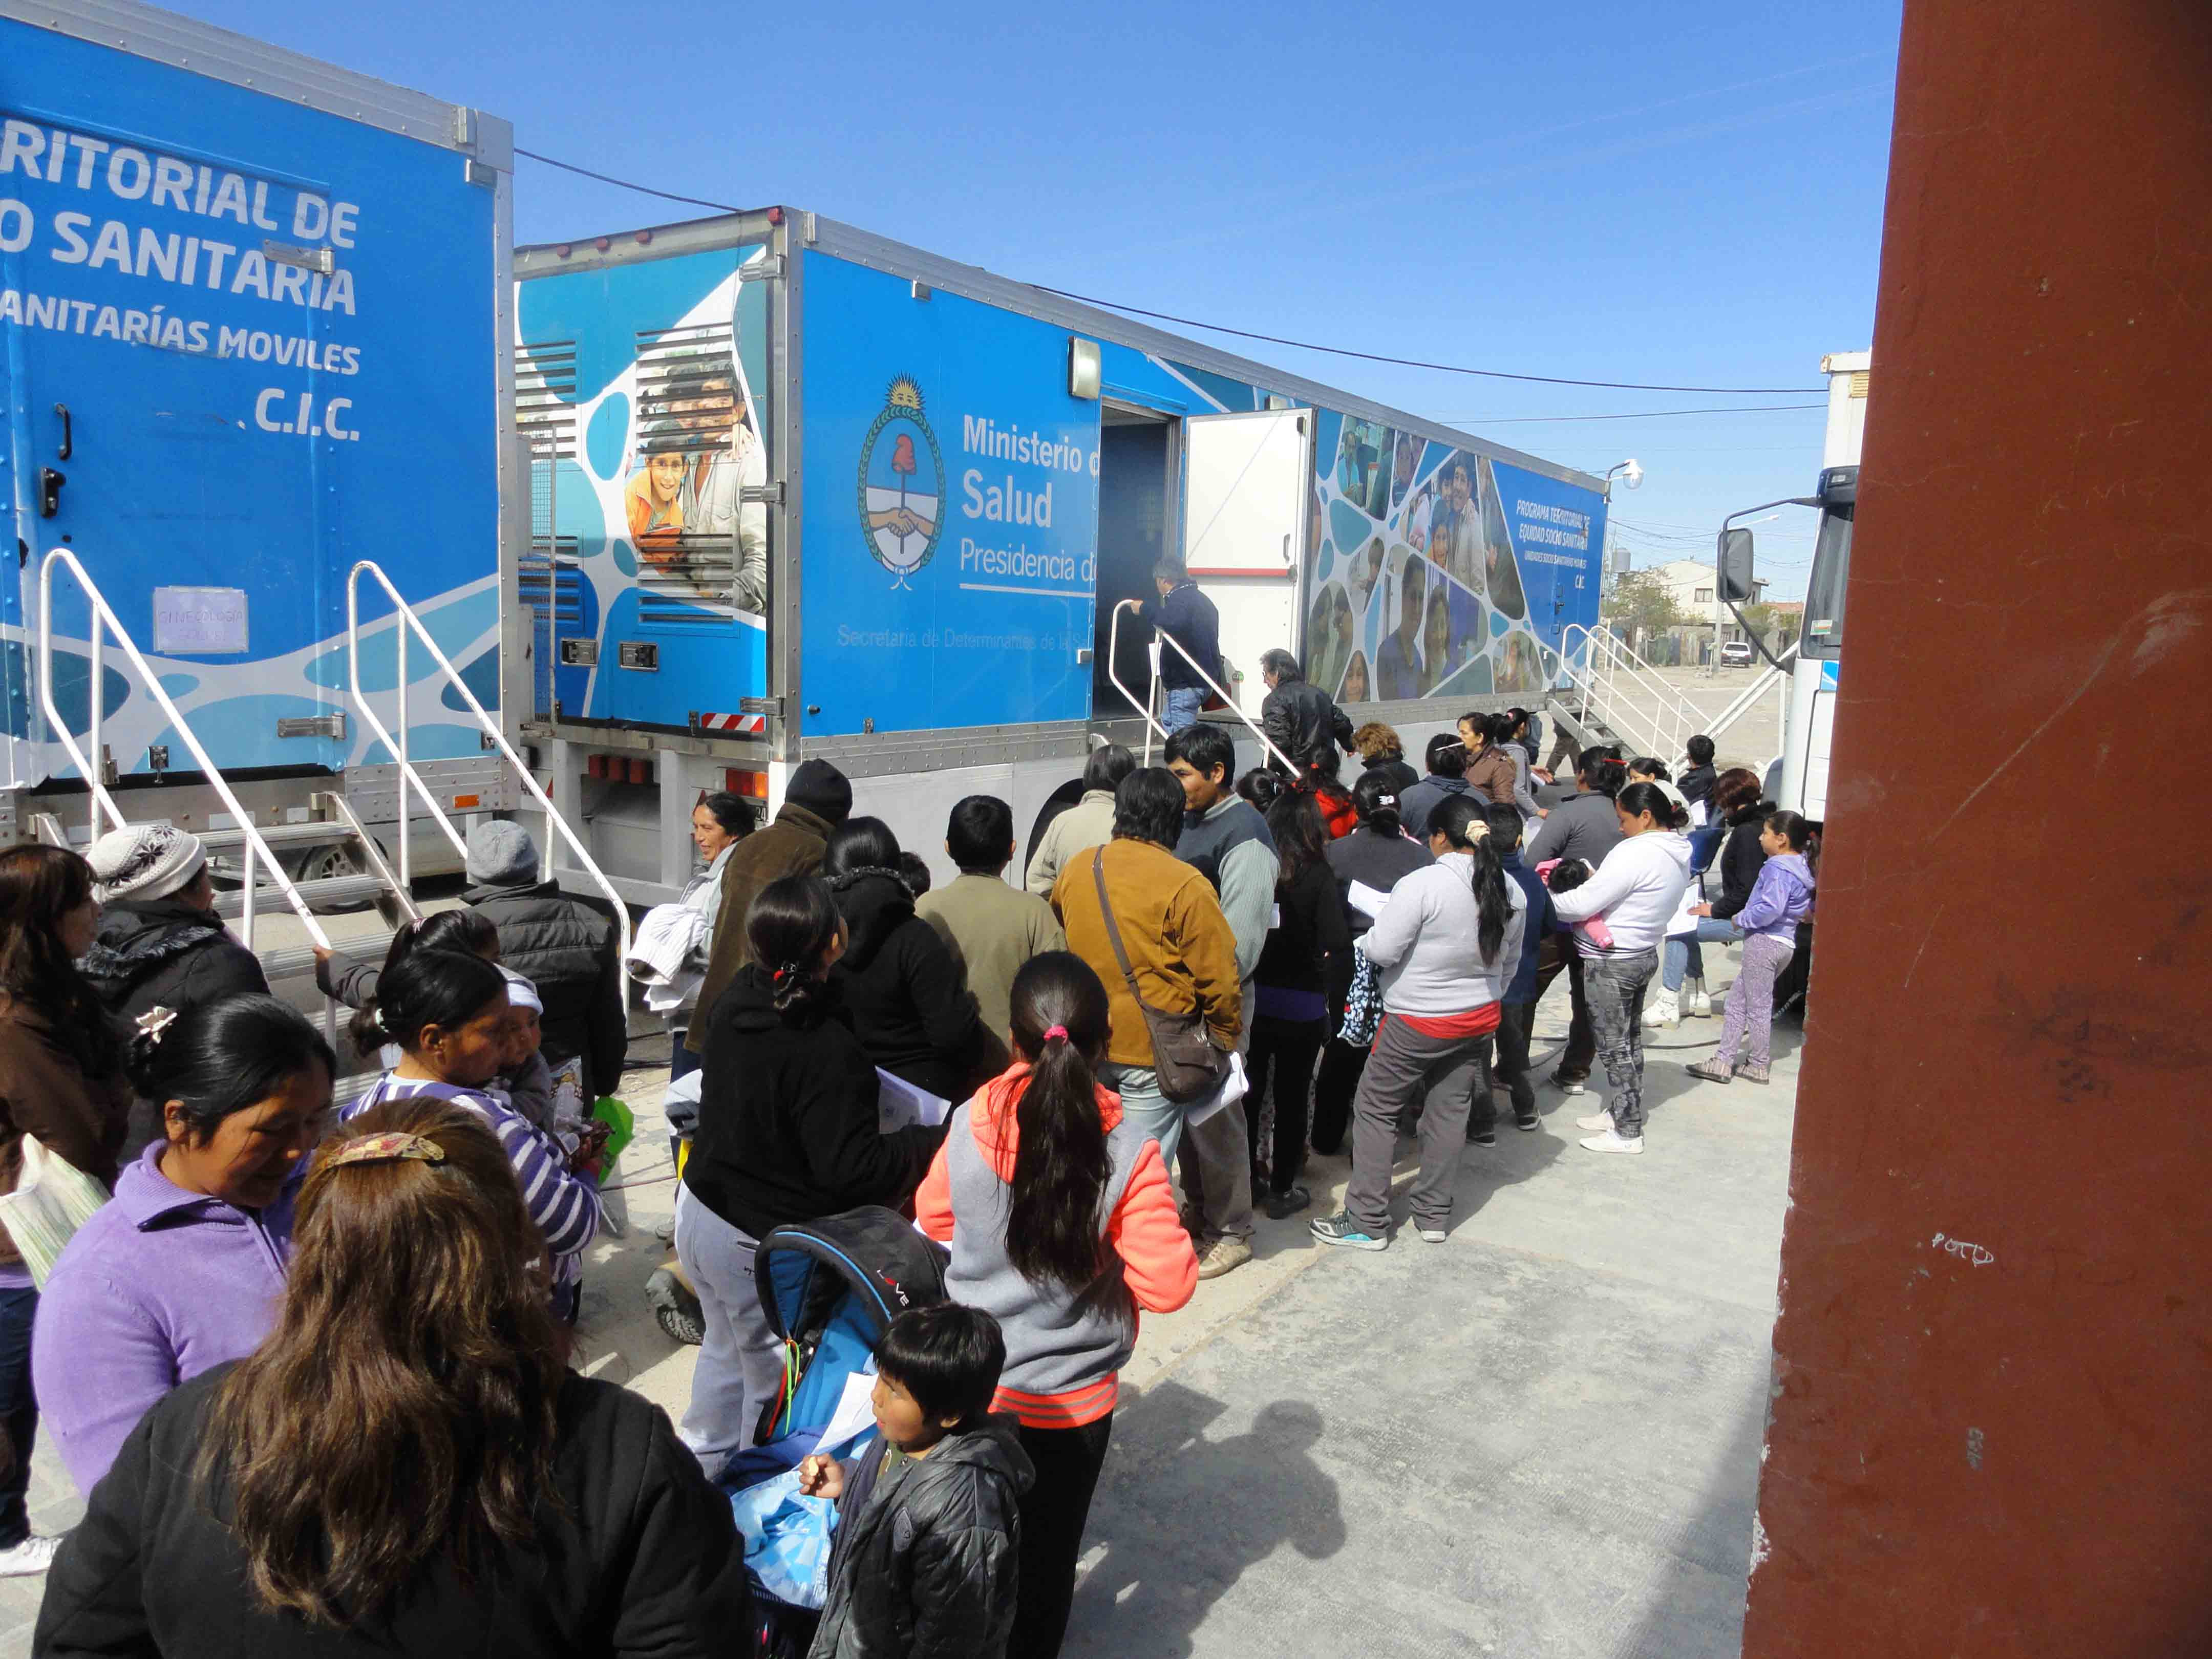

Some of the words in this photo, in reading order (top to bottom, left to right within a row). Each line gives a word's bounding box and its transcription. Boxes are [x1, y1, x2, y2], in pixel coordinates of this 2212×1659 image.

[292, 192, 359, 249] DE
[0, 199, 34, 253] O
[52, 211, 356, 316] SANITARIA
[217, 325, 360, 376] MOVILES
[256, 388, 359, 442] C.I.C.
[963, 414, 1082, 473] Ministerio
[962, 469, 1053, 528] Salud
[1516, 499, 1549, 521] PROGRAMA
[960, 537, 1075, 580] Presidencia
[1519, 523, 1545, 543] EQUIDAD
[922, 628, 939, 648] de
